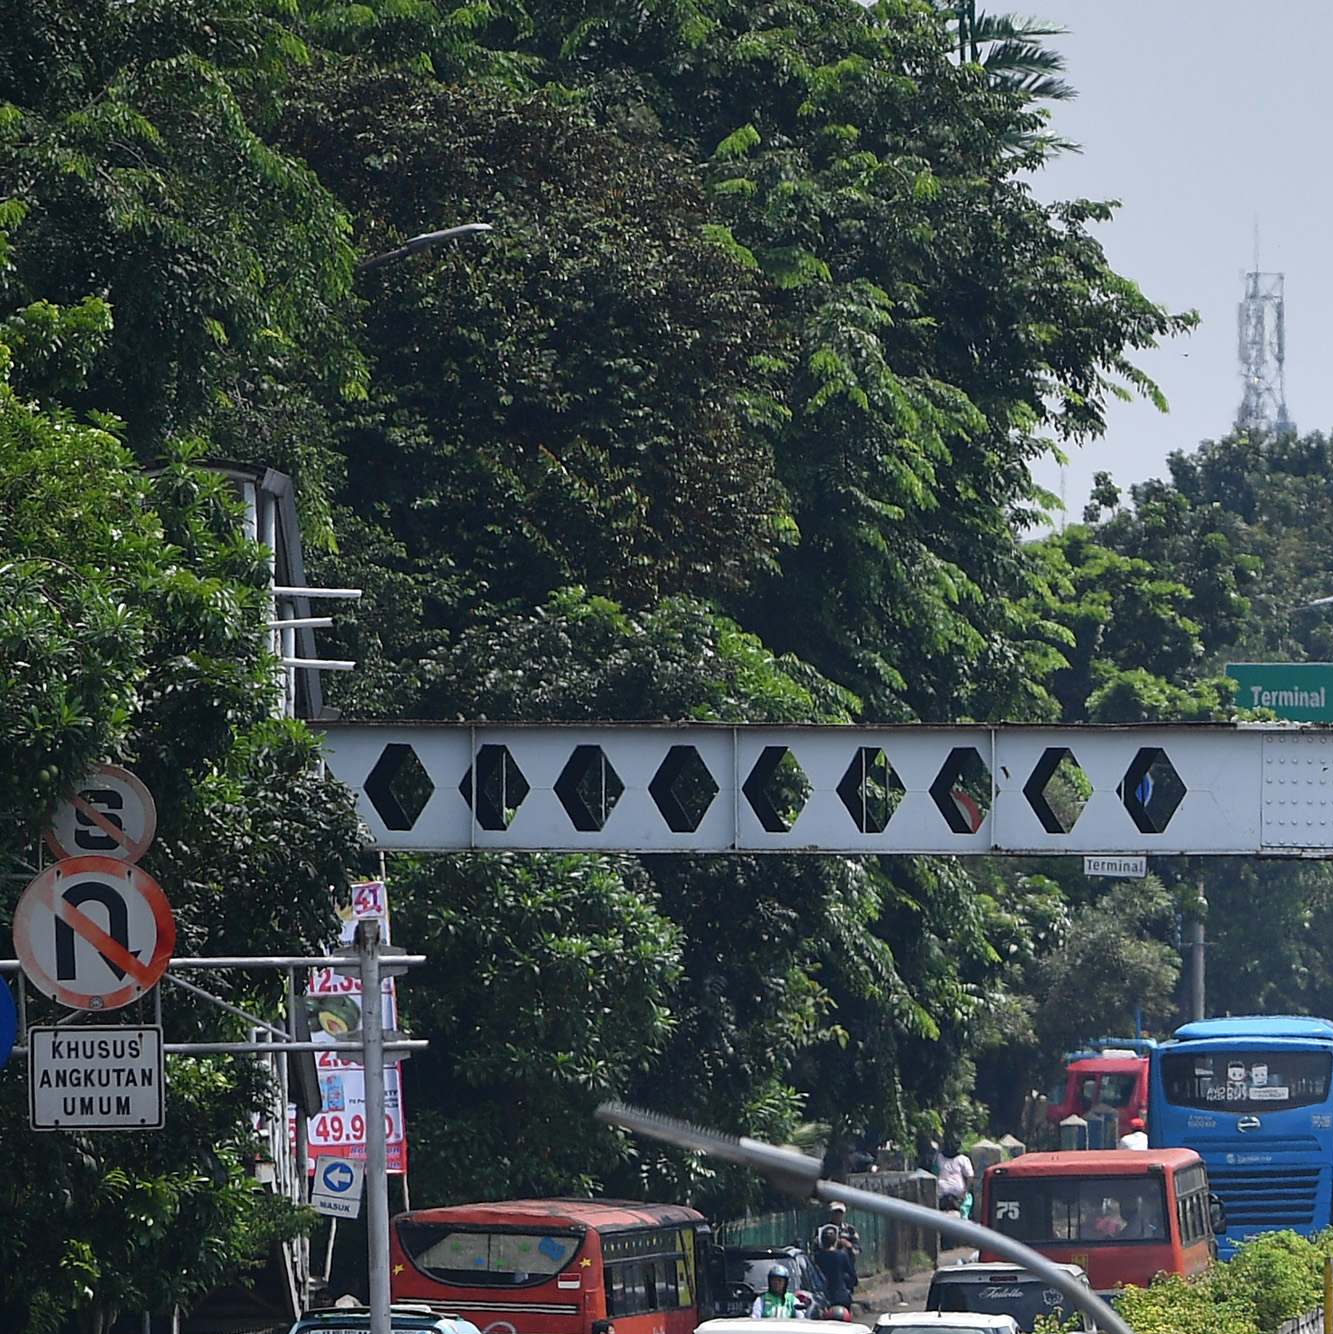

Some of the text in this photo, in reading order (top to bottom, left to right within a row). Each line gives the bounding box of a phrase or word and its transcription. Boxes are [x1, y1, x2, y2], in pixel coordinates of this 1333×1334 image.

[1250, 685, 1326, 707] Terminal
[1087, 859, 1144, 873] Terminal
[51, 1040, 141, 1060] KHUSUS
[39, 1068, 153, 1088] ANGKUTAN
[63, 1097, 131, 1116] UMUM
[319, 1201, 351, 1213] MASUK
[996, 1201, 1020, 1219] 75
